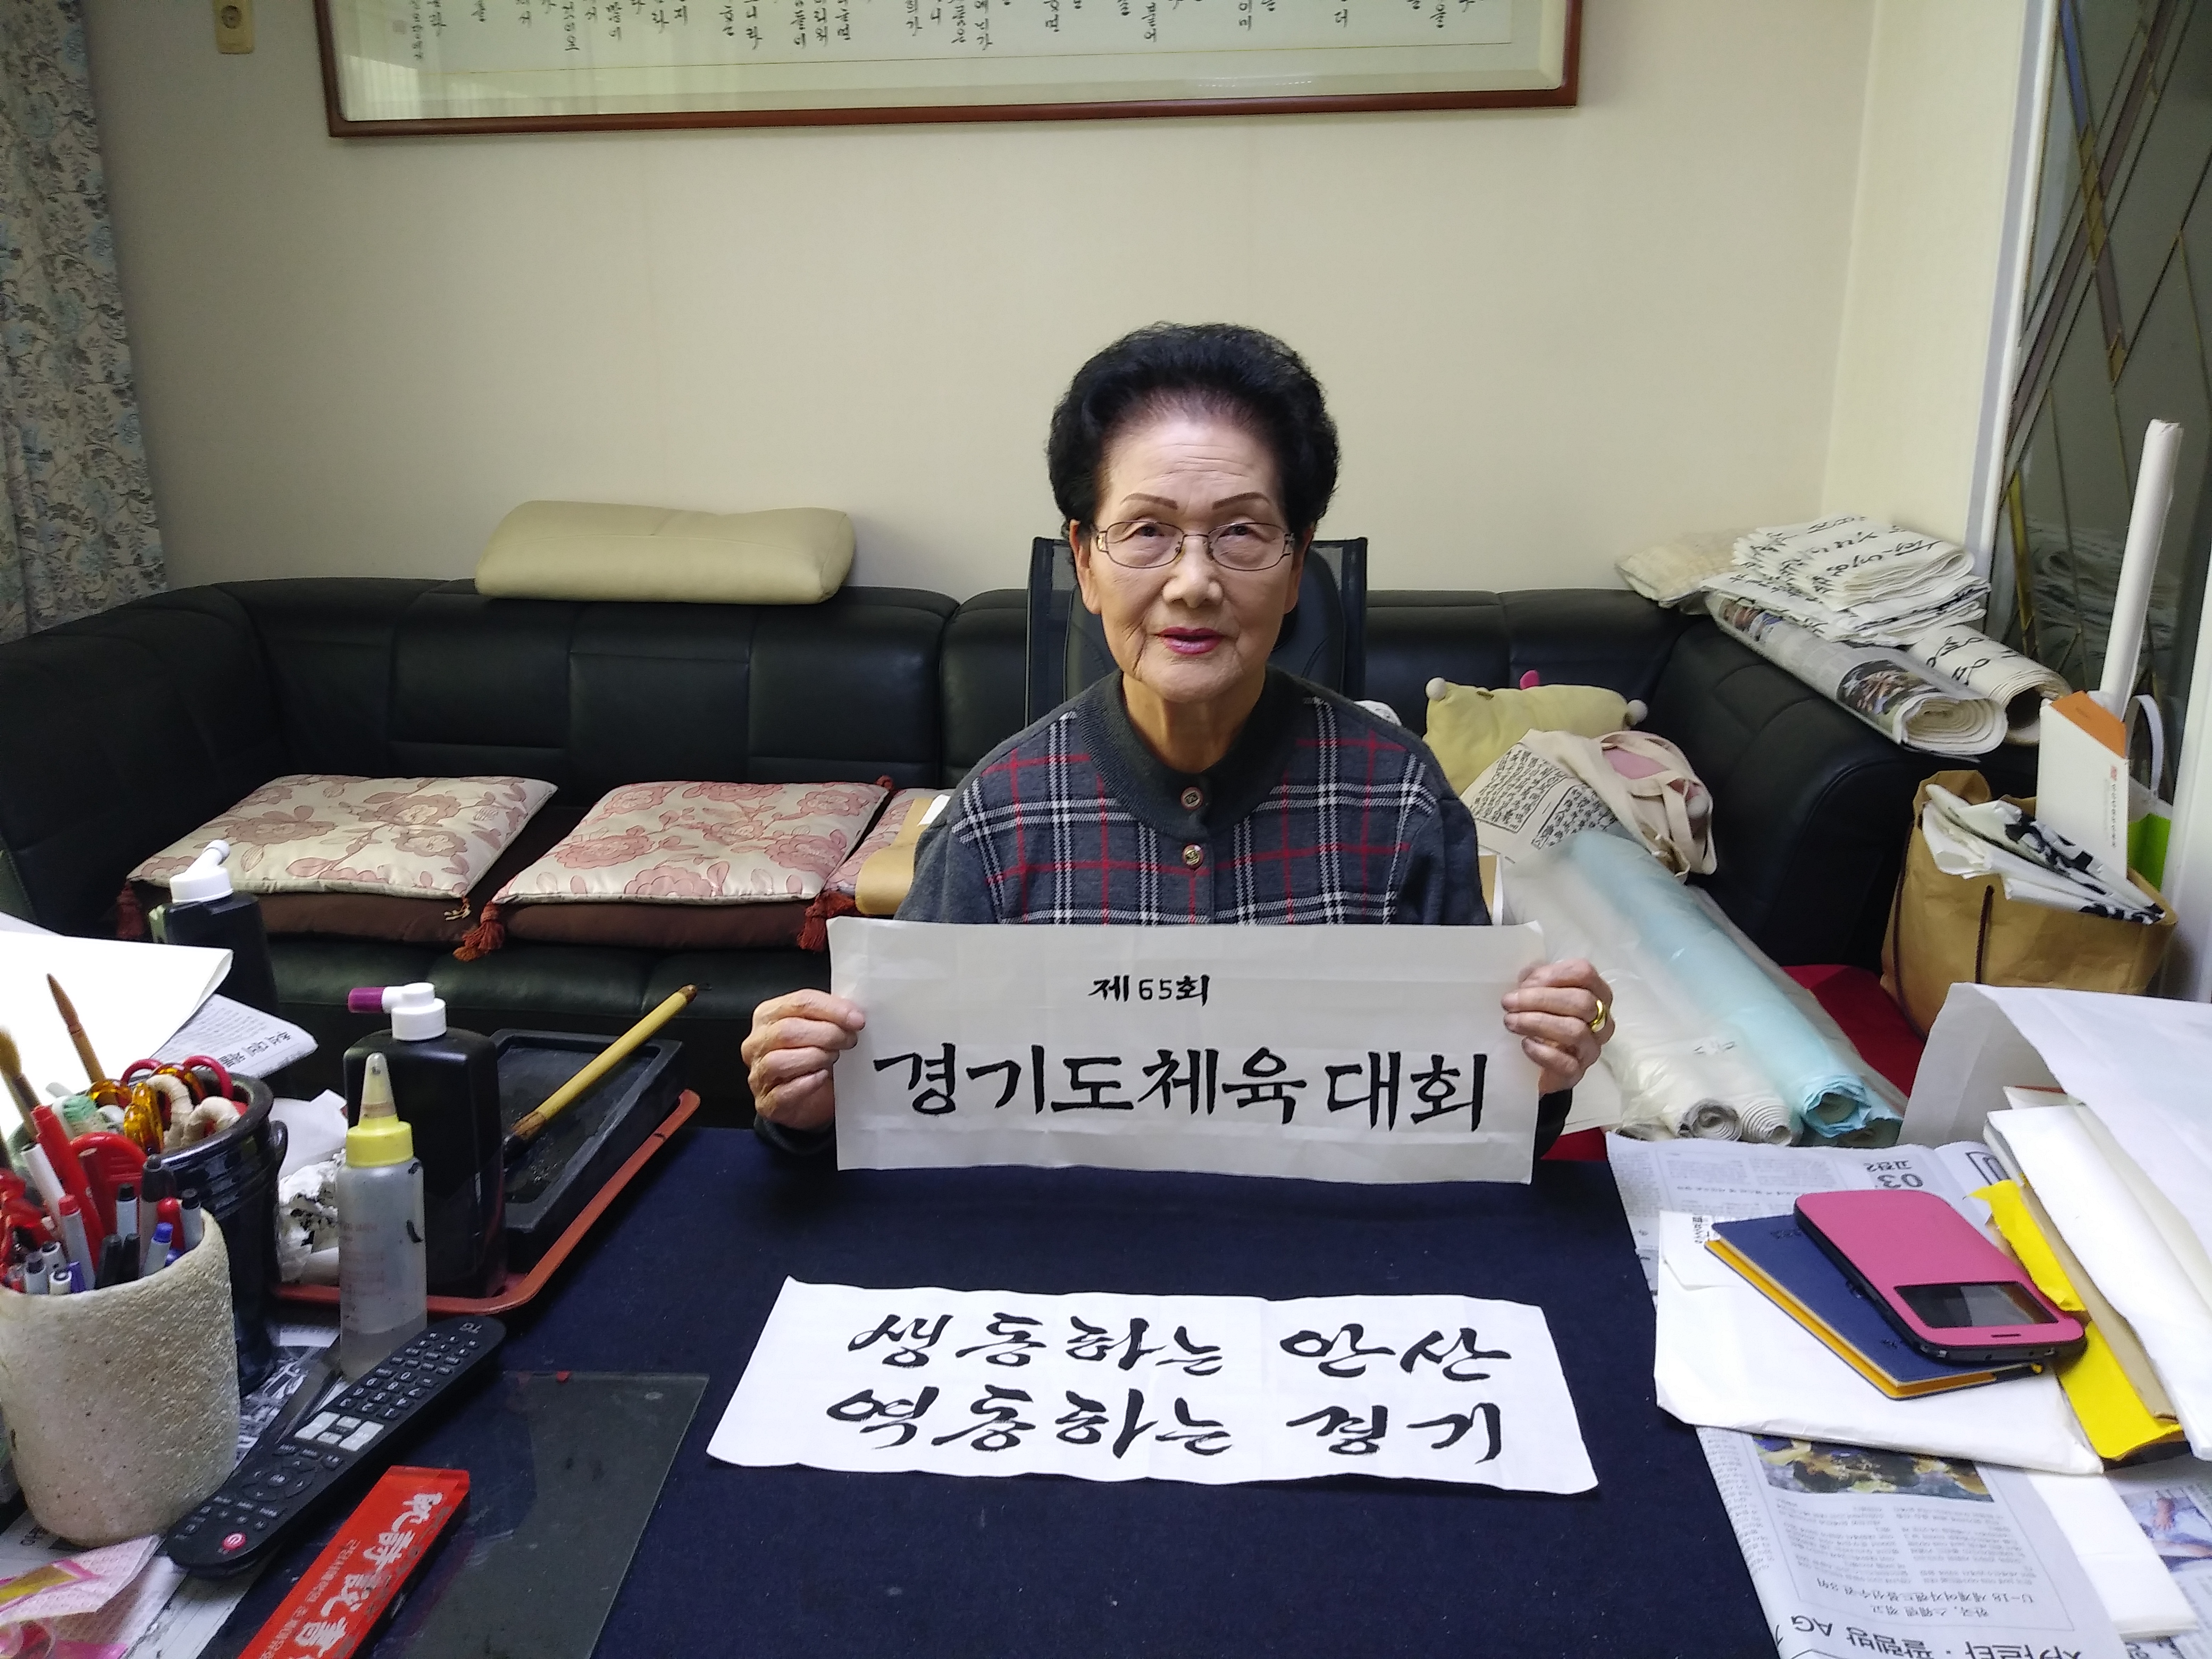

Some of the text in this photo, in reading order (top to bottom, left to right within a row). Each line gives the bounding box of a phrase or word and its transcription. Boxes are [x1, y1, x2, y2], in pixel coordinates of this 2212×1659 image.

[1088, 974, 1211, 1007] 제65회
[1878, 1173, 1923, 1188] 03
[847, 1312, 1512, 1382] 생동하는 안산
[826, 1384, 1502, 1463] 역동하는 경기
[1790, 1614, 1833, 1638] AG
[1845, 1625, 1933, 1659] 팔렘방
